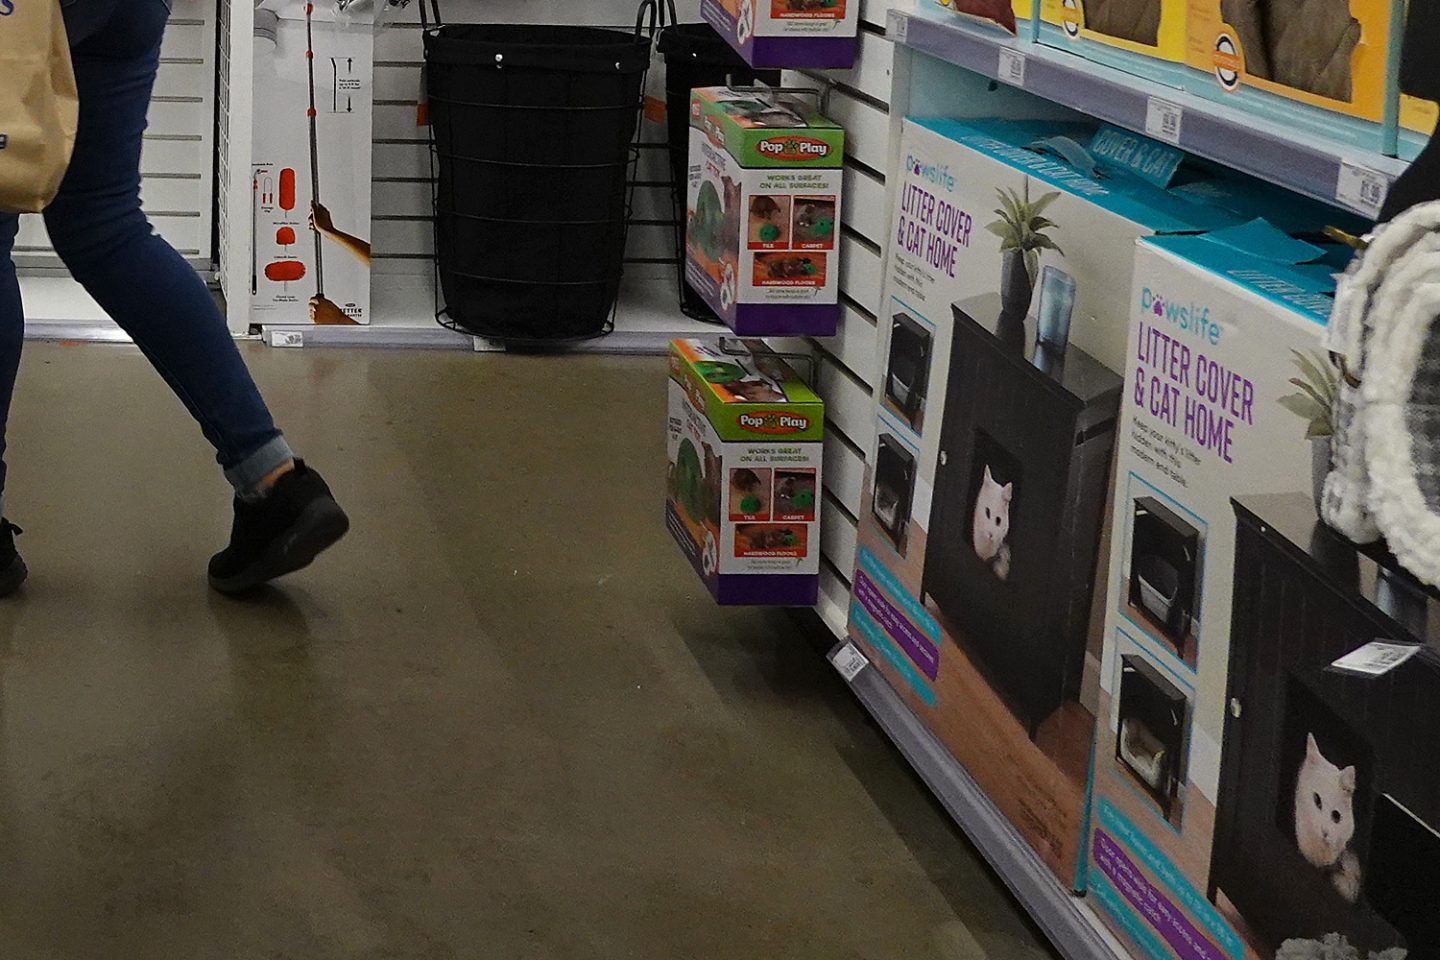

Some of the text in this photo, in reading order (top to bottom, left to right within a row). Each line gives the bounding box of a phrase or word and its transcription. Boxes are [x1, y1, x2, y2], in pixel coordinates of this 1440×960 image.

[759, 141, 828, 156] Pop Play
[1093, 133, 1131, 162] COVER
[767, 174, 822, 182] WORKS GREAT
[901, 181, 972, 248] LITTER COVER
[897, 215, 906, 246] &
[906, 220, 928, 261] CAT
[927, 231, 958, 278] HOME
[1137, 321, 1255, 426] LITTER COVER
[740, 414, 808, 430] Pop Play
[1134, 367, 1235, 465] & CAT HOME
[747, 447, 802, 455] WORKS GREAT
